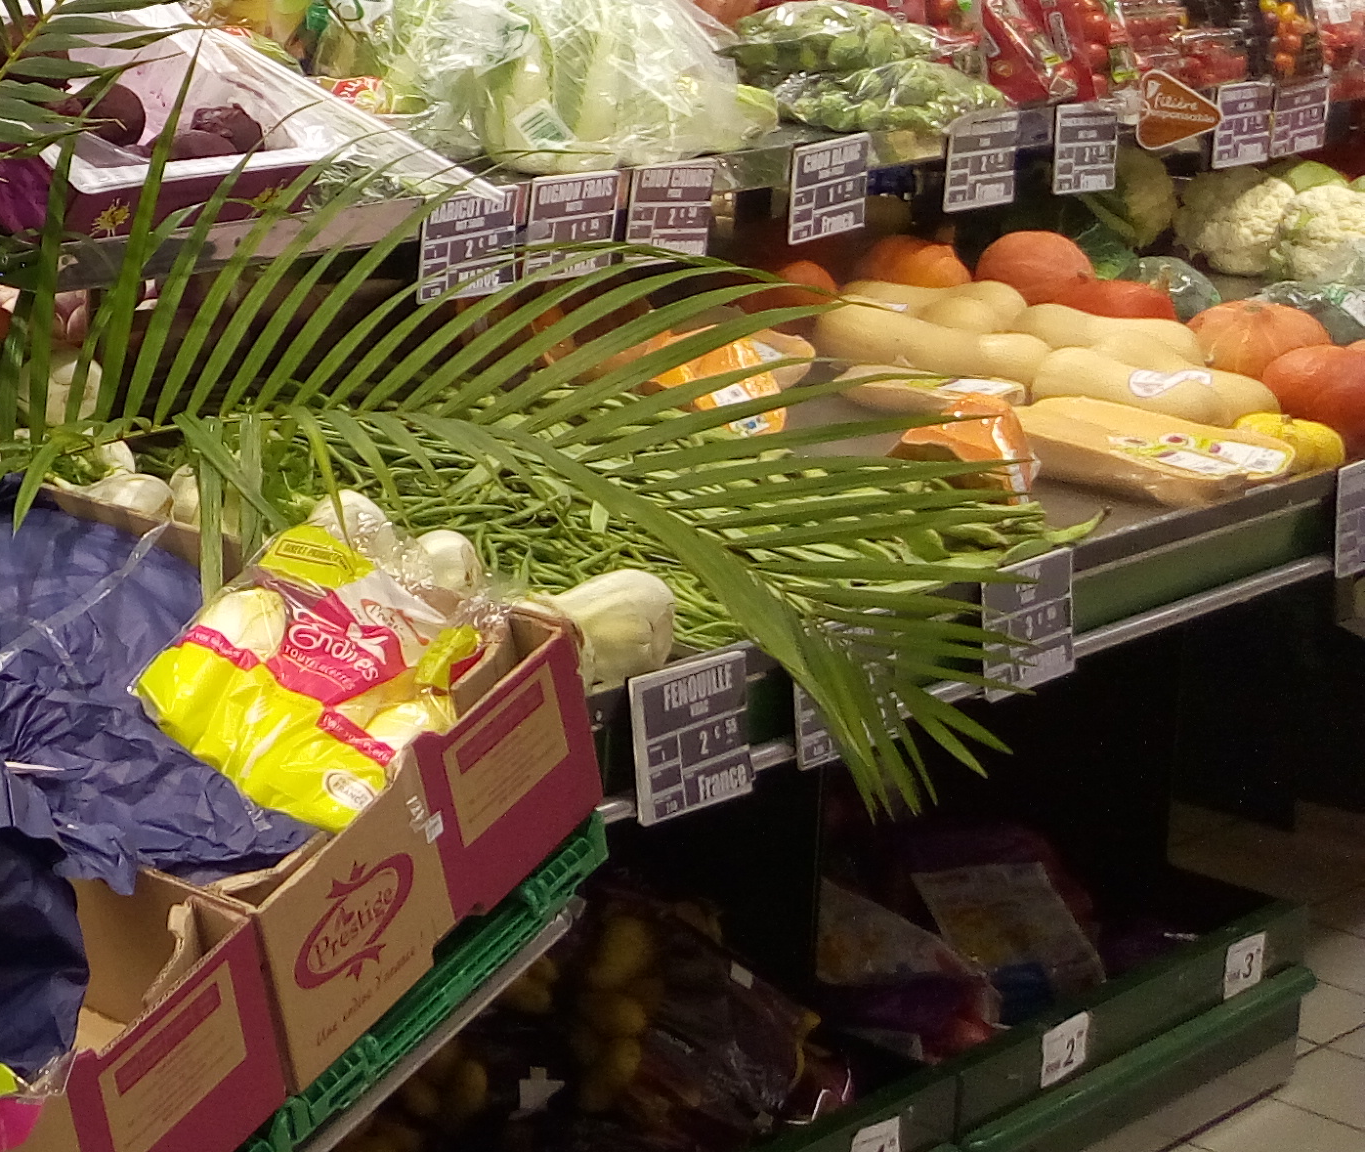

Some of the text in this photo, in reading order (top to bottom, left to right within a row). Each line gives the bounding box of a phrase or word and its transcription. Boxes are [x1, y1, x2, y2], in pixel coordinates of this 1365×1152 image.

[539, 177, 614, 205] OIGNON FRAIS
[641, 170, 669, 188] CHOU
[289, 623, 379, 682] Endives
[664, 663, 733, 711] FENOUILLE
[699, 730, 709, 755] 2
[698, 763, 747, 801] France
[315, 887, 394, 968] Prestige
[1242, 952, 1254, 979] 3
[1063, 1038, 1076, 1068] 2
